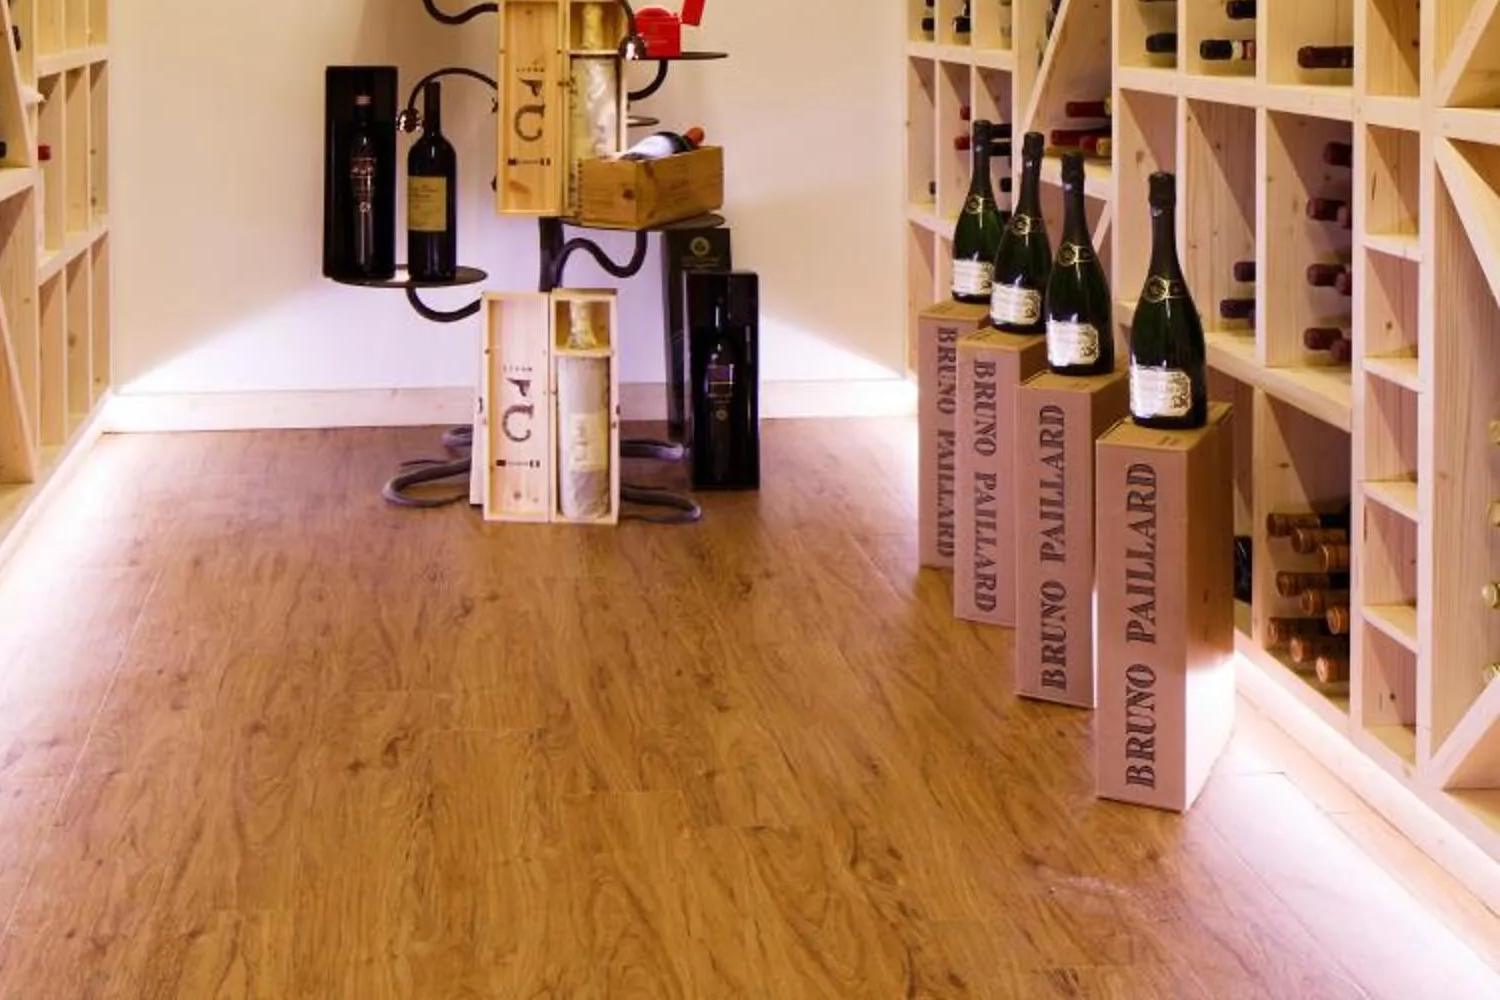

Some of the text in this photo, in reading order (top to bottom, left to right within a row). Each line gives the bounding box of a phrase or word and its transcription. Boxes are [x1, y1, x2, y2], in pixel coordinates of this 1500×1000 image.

[937, 326, 958, 558] BRUNO PAILLARD
[973, 359, 997, 613] BRUNO PAILLARD
[1039, 404, 1067, 692] BRUNO PAILLARD
[1125, 462, 1157, 790] BRUNO PAILLARD
